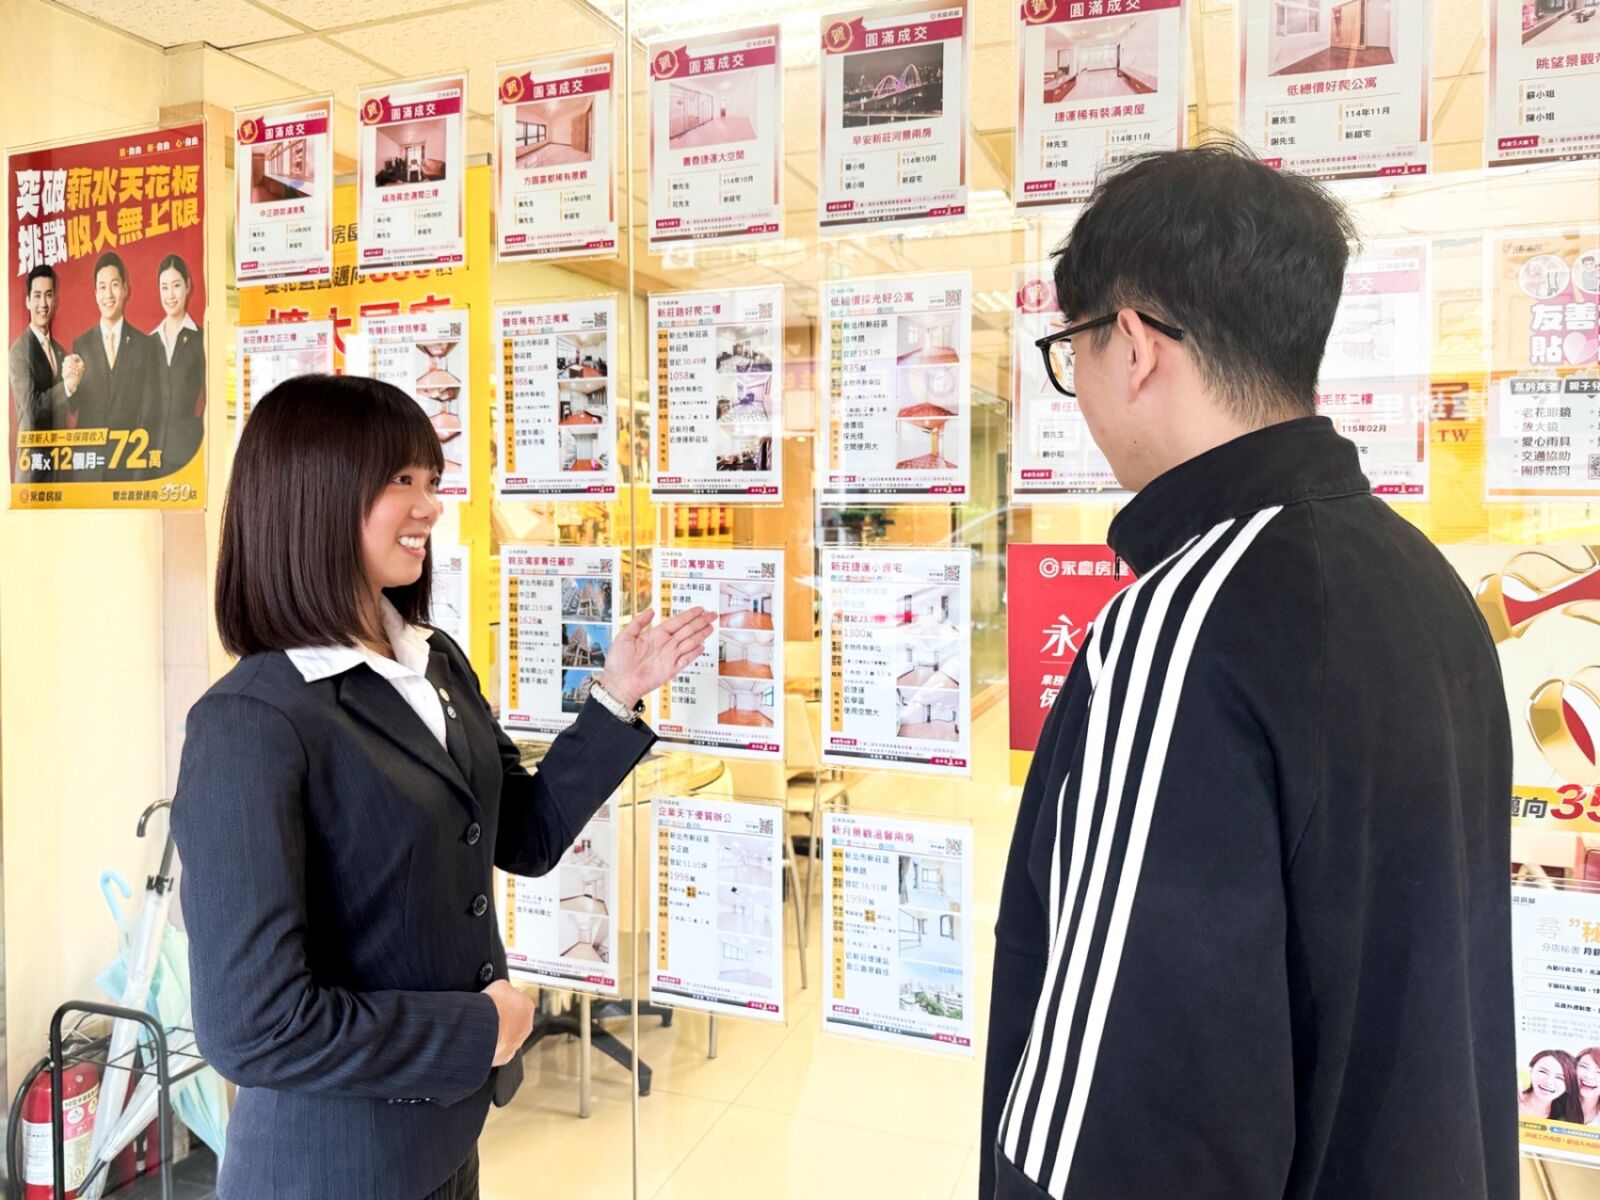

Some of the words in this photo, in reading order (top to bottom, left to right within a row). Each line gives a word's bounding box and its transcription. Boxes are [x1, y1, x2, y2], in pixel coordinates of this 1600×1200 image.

[1070, 0, 1141, 18] 圓滿成交
[865, 26, 928, 48] 圓滿成交
[689, 54, 745, 74] 圓滿成交
[533, 80, 584, 99] 圓滿成交
[1287, 76, 1377, 96] 低總價好爬公寓
[391, 102, 437, 120] 圓滿成交
[1054, 103, 1145, 123] 捷運稀有裝潢美屋
[1345, 106, 1390, 118] 114年11月
[264, 123, 305, 140] 圓滿成交
[852, 127, 932, 145] 早安新莊河景兩房
[1111, 132, 1151, 143] 114年11月
[902, 155, 937, 164] 114年10月
[15, 165, 200, 220] 突破薪水天花板
[17, 197, 200, 277] 挑戰收入無上限
[657, 305, 721, 318] 新莊路好爬二樓
[1531, 302, 1597, 331] 友善
[1522, 407, 1571, 418] 老花眼鏡
[1342, 424, 1387, 433] 115年02月
[1522, 422, 1559, 432] 放大鏡
[1521, 451, 1570, 461] 交通協助
[661, 560, 725, 570] 三樓公寓學區宅
[831, 562, 902, 573] 新莊捷運小資宅
[658, 807, 732, 823] 企業天下優質辦公
[831, 825, 915, 843] 新月景觀溫馨兩房
